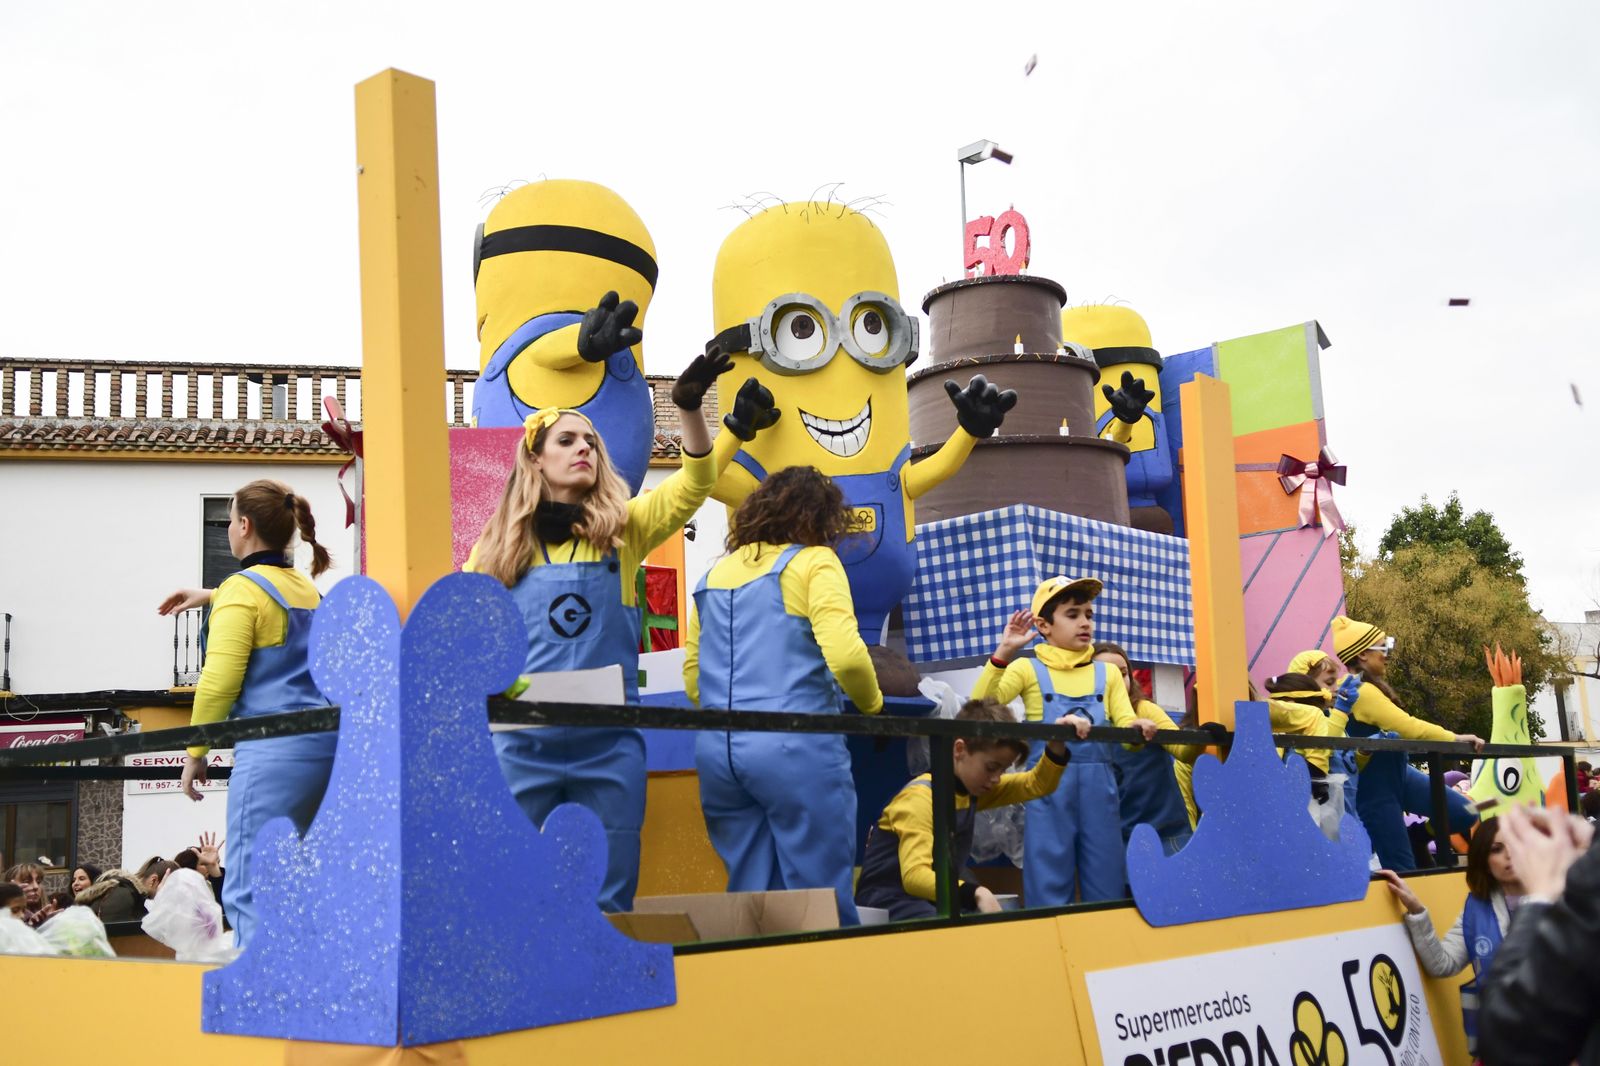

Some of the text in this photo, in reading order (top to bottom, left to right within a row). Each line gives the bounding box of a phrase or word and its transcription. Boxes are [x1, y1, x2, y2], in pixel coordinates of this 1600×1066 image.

[965, 210, 1031, 280] 50
[132, 757, 188, 766] SERVIC
[1115, 990, 1251, 1042] Supermercados
